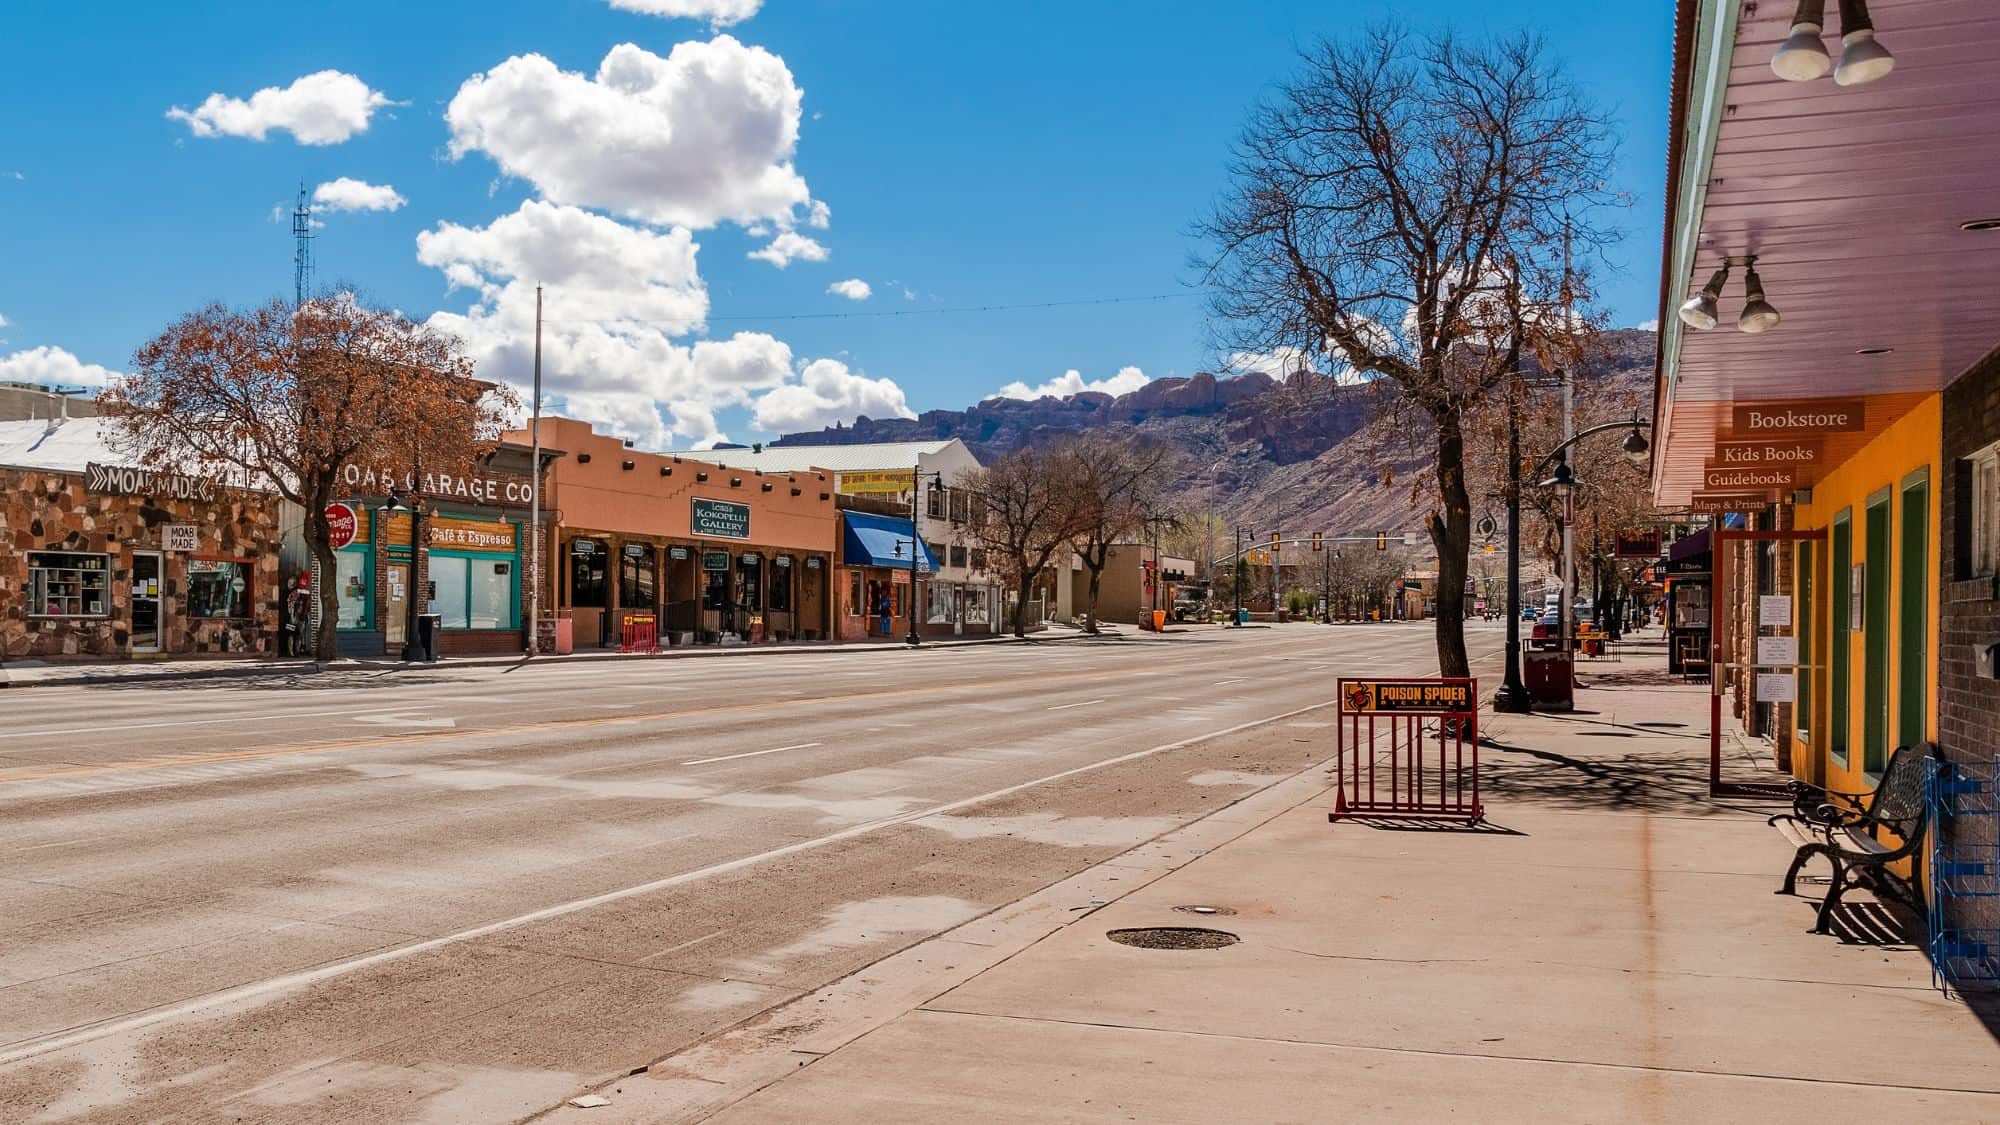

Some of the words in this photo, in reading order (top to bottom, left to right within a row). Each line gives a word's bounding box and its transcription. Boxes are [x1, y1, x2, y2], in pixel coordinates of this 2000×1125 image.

[1748, 410, 1848, 429] Bookstore
[1724, 448, 1760, 463] Kids
[1765, 446, 1814, 461] Books
[107, 468, 155, 496] MOAB
[157, 475, 198, 500] MADE
[335, 463, 394, 488] OAB
[506, 482, 532, 502] CO
[1708, 472, 1791, 487] Guidebooks
[1693, 500, 1721, 511] Maps
[1723, 500, 1732, 510] &
[1735, 499, 1766, 510] Prints
[700, 518, 743, 531] GALLERY
[171, 527, 194, 538] MOAB
[431, 527, 454, 541] Café
[457, 530, 466, 541] &
[468, 530, 512, 546] Espresso
[170, 538, 194, 549] MADE
[1380, 687, 1421, 700] POISON
[1424, 687, 1466, 701] SPIDER
